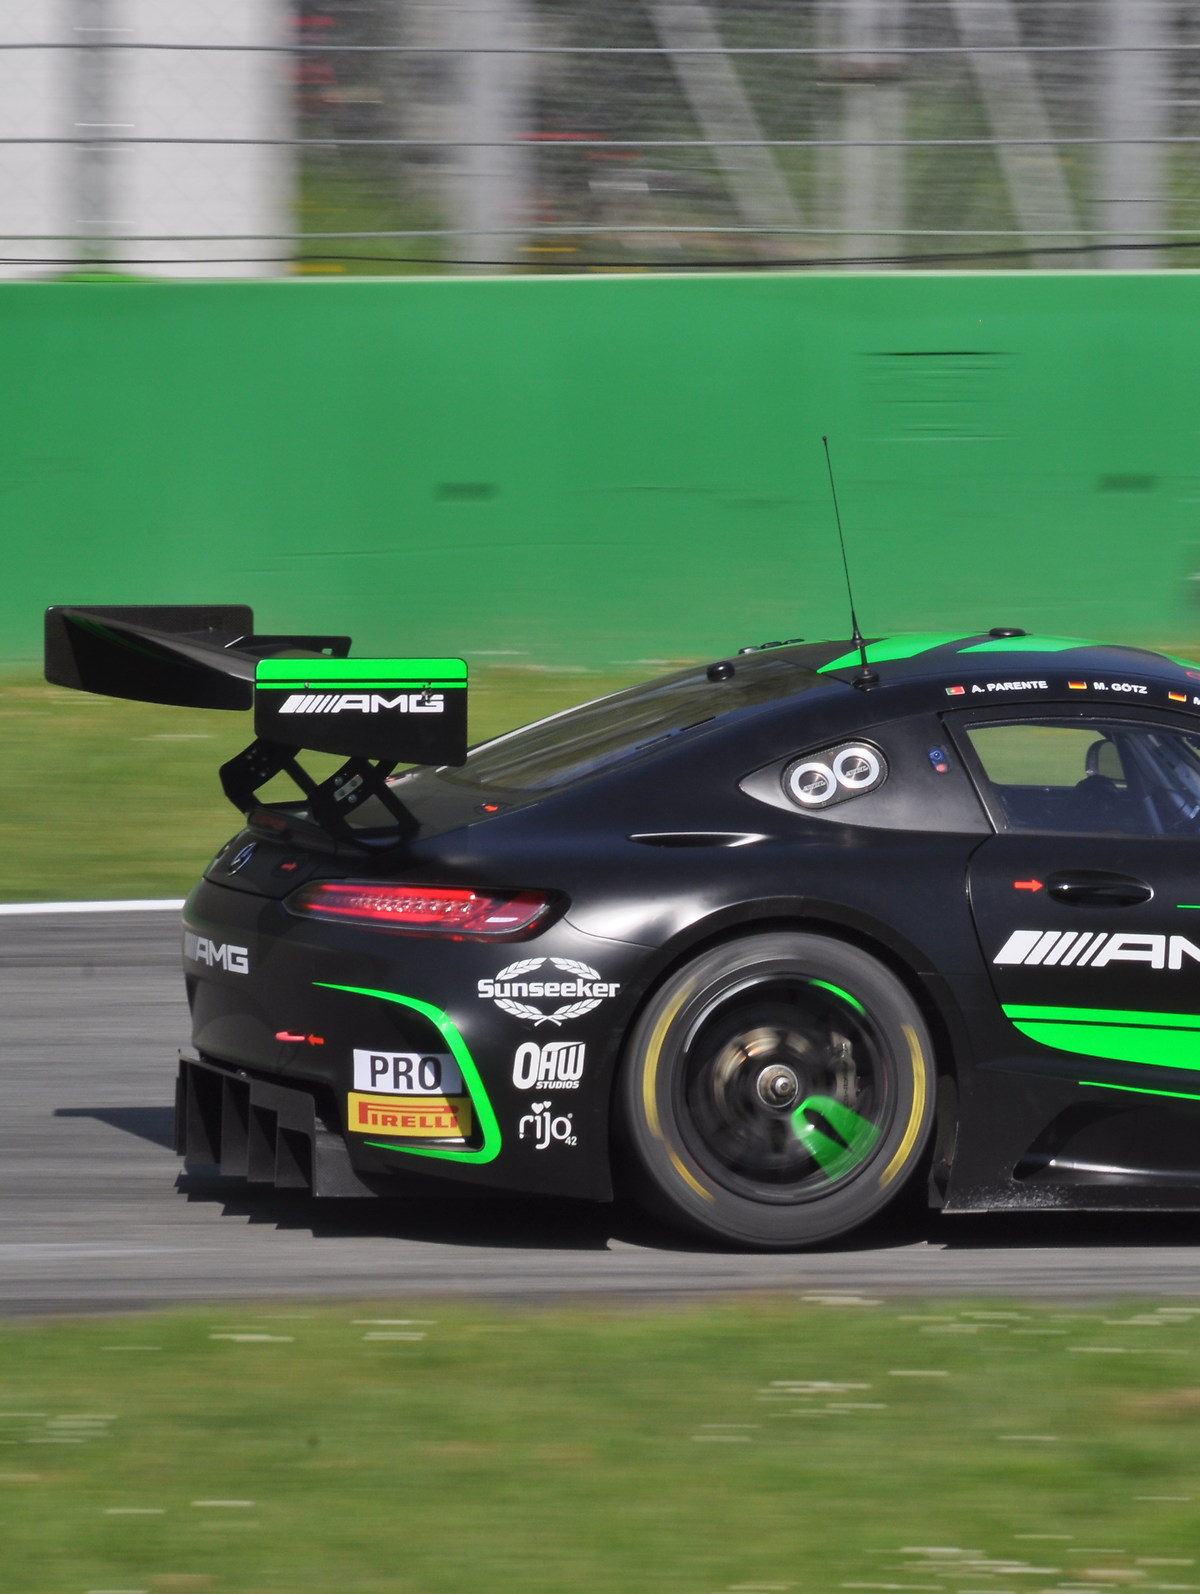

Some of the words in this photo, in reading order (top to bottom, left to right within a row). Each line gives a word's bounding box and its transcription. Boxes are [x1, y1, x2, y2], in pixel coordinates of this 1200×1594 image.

[972, 685, 985, 693] A.
[986, 681, 1048, 692] PARENTE
[1093, 682, 1109, 690] M.
[1111, 682, 1148, 694] GÖTZ
[331, 694, 444, 713] AMG
[195, 936, 249, 975] AMG
[477, 979, 621, 998] Sunseeker
[369, 1055, 442, 1091] PRO
[535, 1080, 580, 1090] STUDIOS
[358, 1101, 459, 1128] PIRELLI
[519, 1100, 572, 1150] rijo
[564, 1135, 578, 1146] 42
